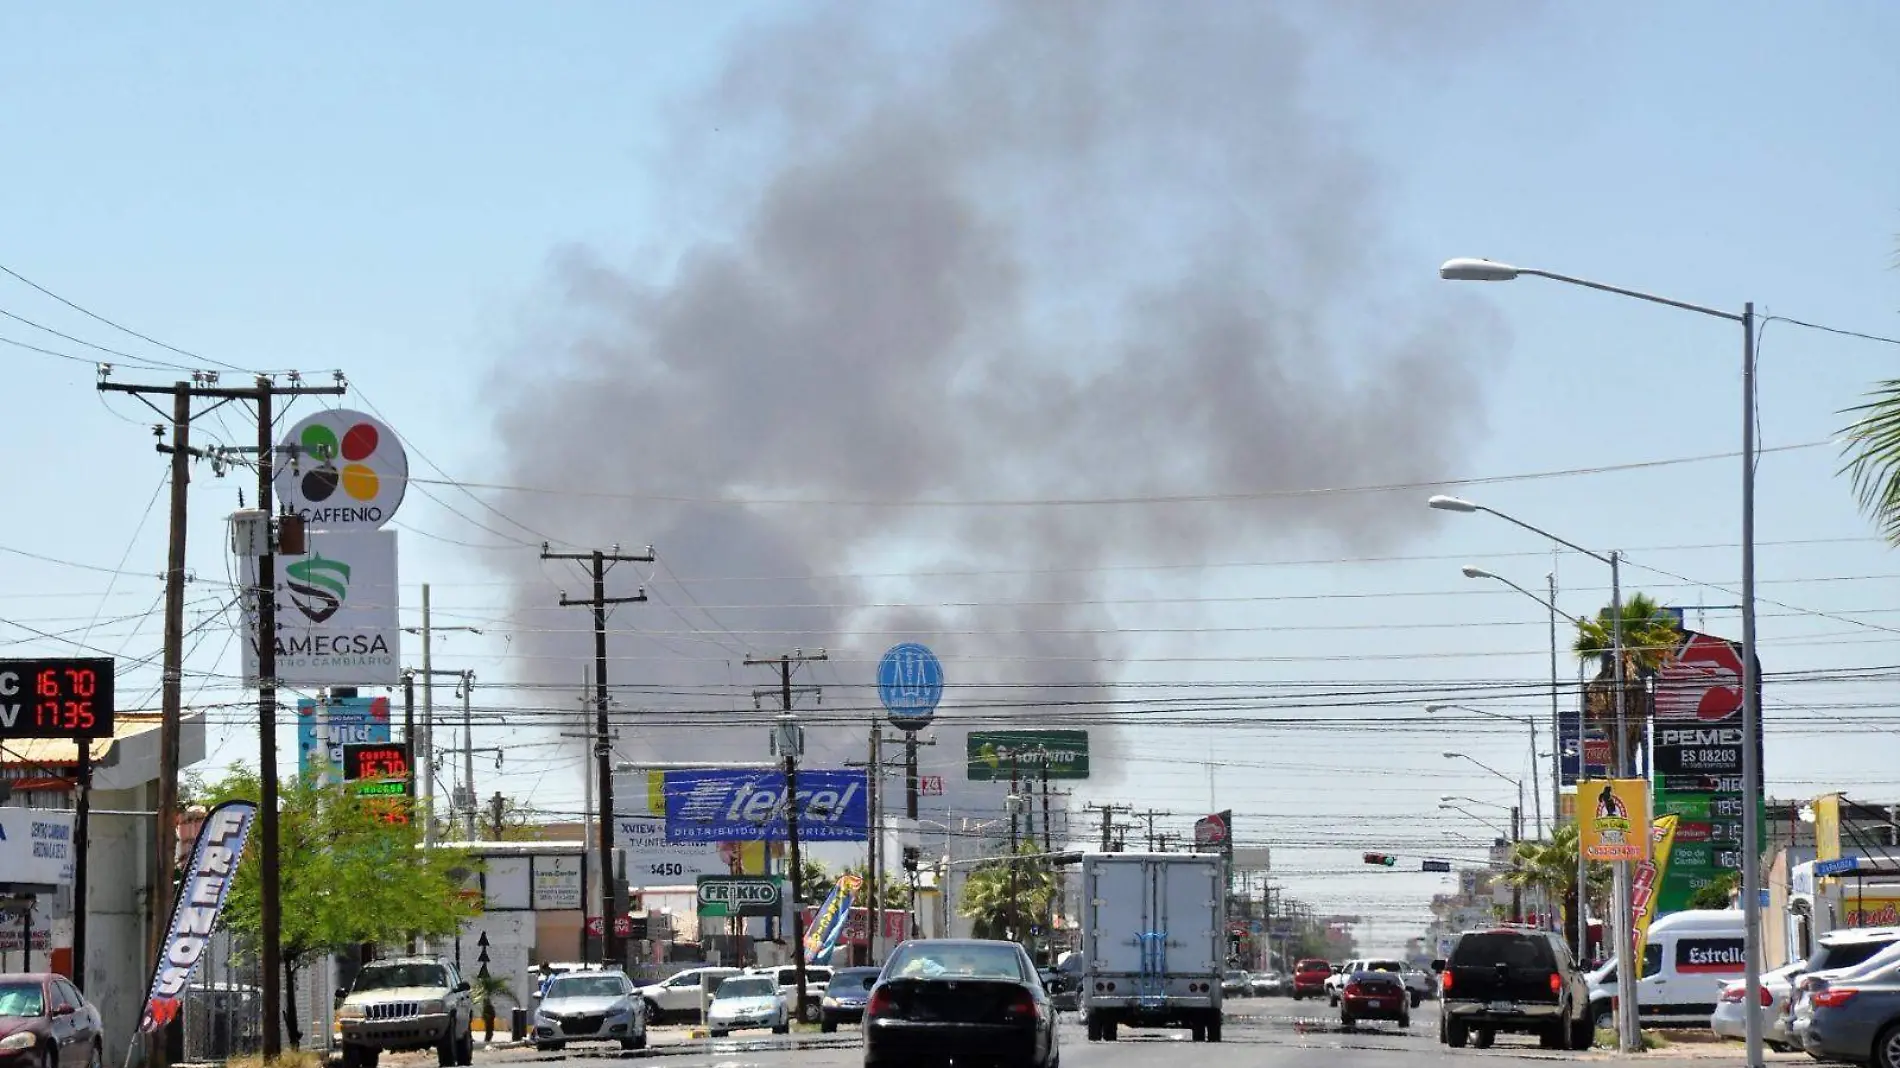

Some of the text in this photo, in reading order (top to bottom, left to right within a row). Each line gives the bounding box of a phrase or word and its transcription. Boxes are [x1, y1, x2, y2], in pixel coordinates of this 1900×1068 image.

[301, 507, 382, 523] CAFFENIO
[250, 655, 393, 668] CTRO CAMBIARIO
[0, 670, 95, 696] C 16.70
[0, 704, 21, 728] V
[1681, 750, 1736, 762] ES 08203
[674, 826, 854, 837] DISTRIBUIDOR AUORIZADO
[651, 863, 683, 877] $450
[705, 885, 774, 901] FRIKKO
[157, 811, 246, 997] FRENOS
